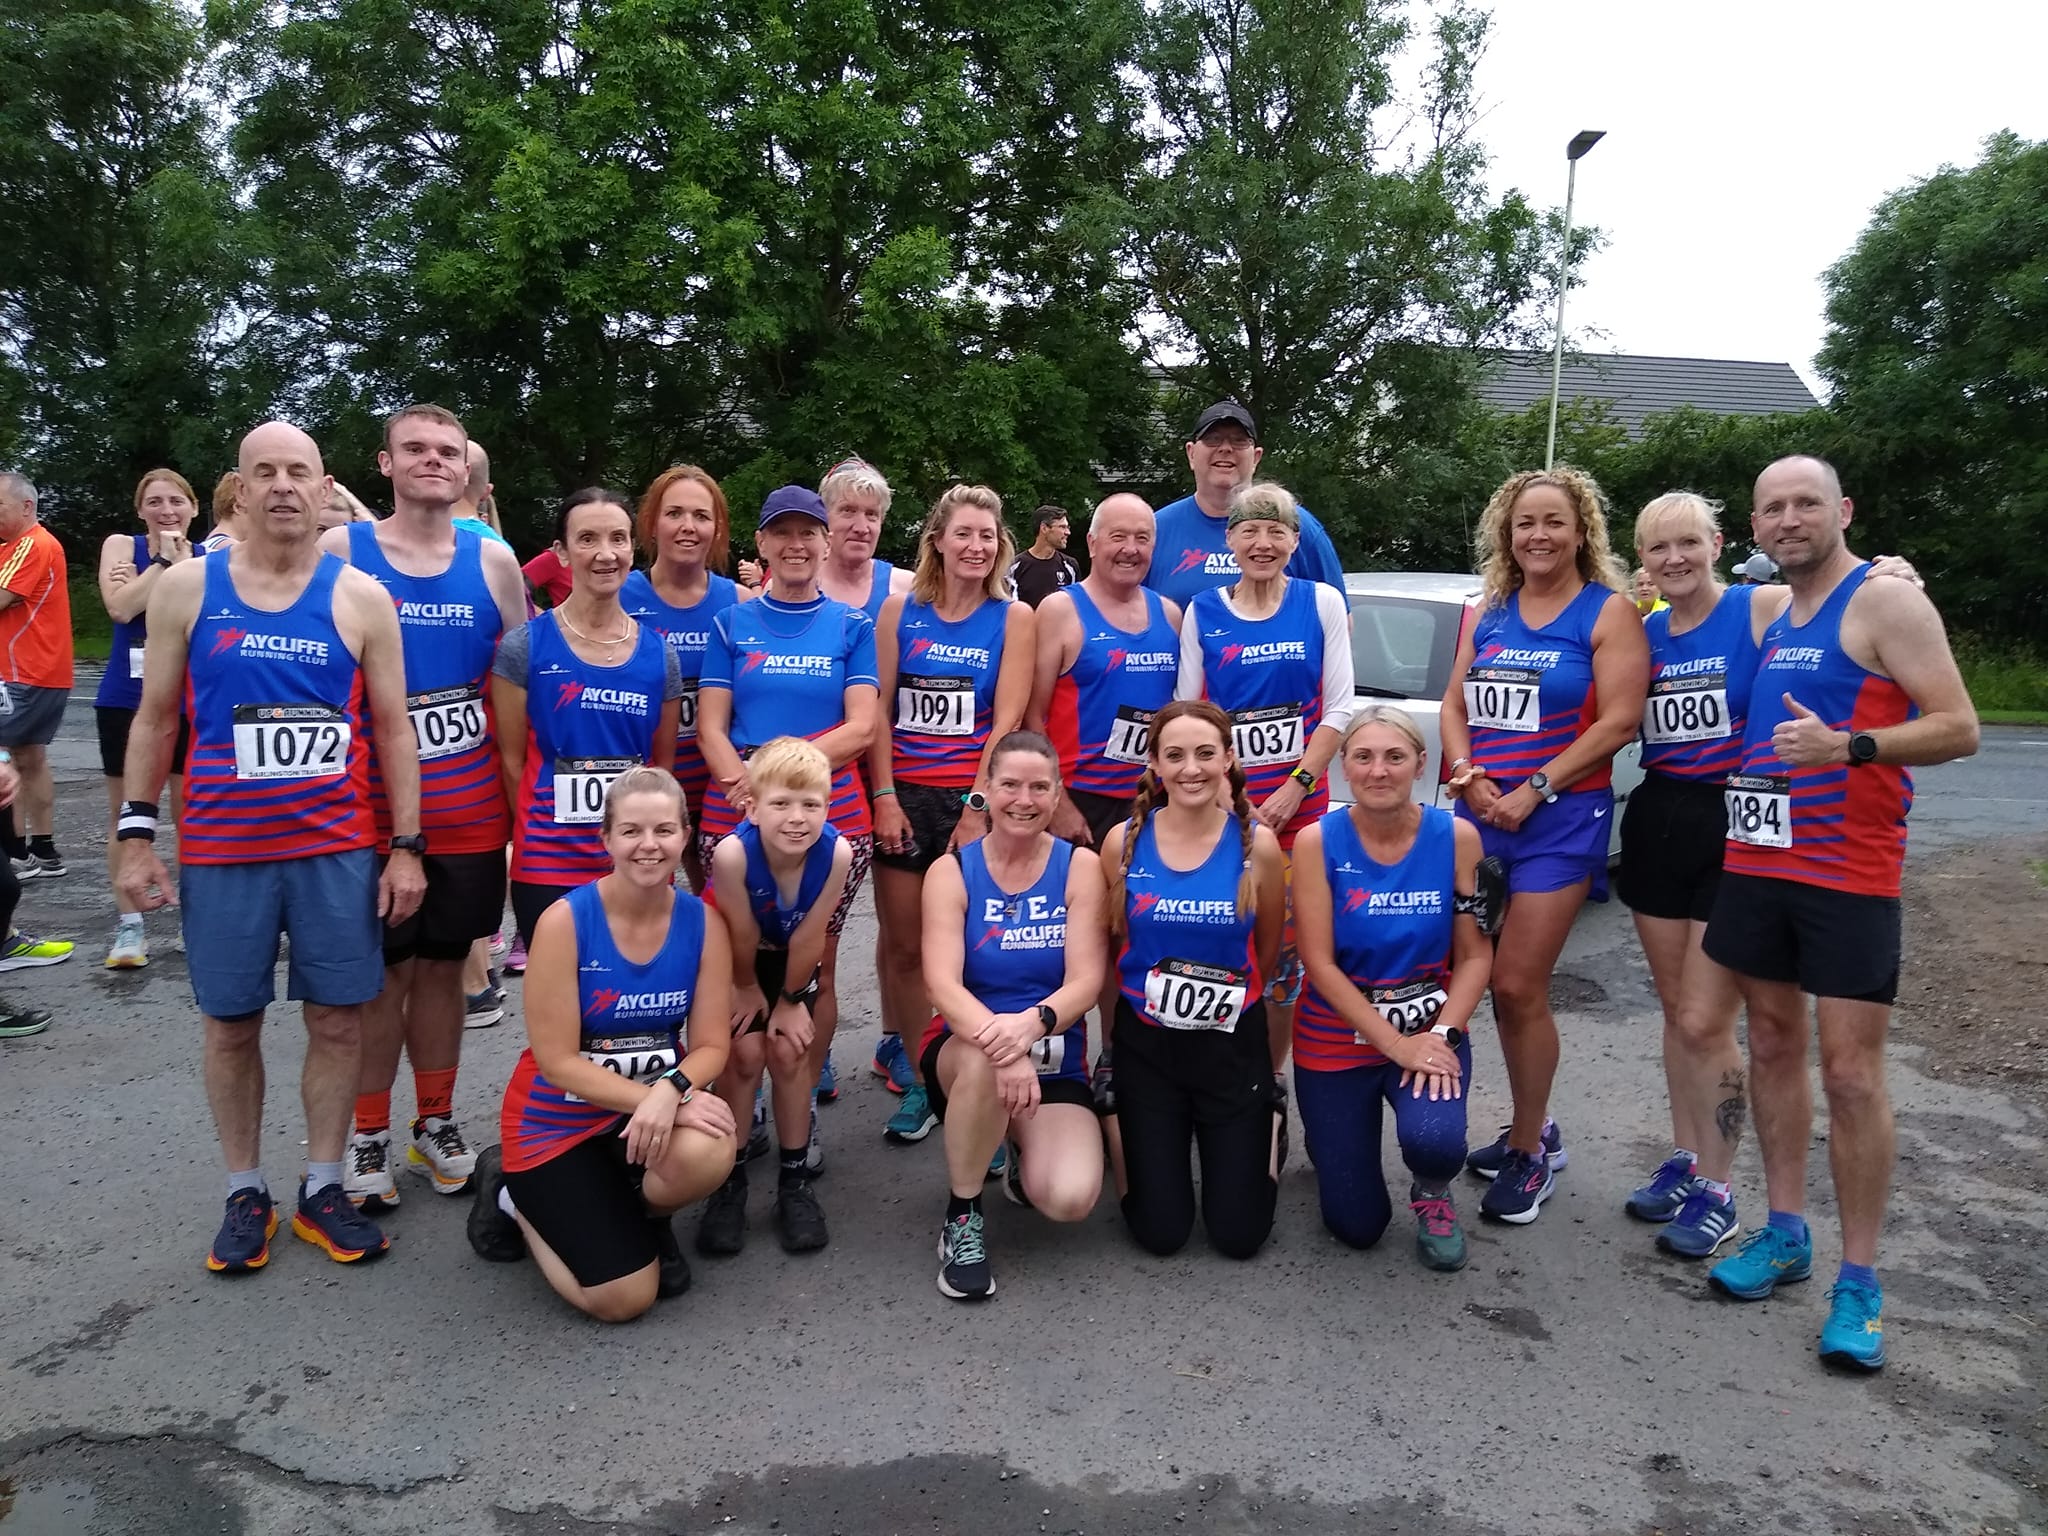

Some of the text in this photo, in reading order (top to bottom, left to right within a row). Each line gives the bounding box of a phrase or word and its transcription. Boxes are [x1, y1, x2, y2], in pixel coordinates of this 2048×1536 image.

[400, 602, 474, 619] AYCLIFFE
[400, 618, 474, 627] RUNNING CLUB
[241, 634, 329, 657] AYCLIFFE
[928, 643, 989, 663] AYCLIFFE
[1241, 641, 1305, 658] AYCLIFFE
[240, 650, 328, 666] RUNNING CLUB
[764, 655, 832, 670] AYCLIFFE
[926, 655, 988, 670] RUNNING CLUB
[1125, 652, 1175, 665] AYCLIFFE
[1241, 652, 1306, 665] RUNNING CLUB
[1492, 659, 1530, 667] RUNNING
[1496, 649, 1561, 662] AYCLIFFE
[1771, 648, 1824, 663] AYCLIFFE
[809, 669, 832, 677] CLUB
[1660, 656, 1726, 677] AYCLIFFE
[1797, 663, 1819, 671] CLUB
[581, 687, 648, 708] AYCLIFFE
[1475, 685, 1532, 720] 1017
[580, 702, 647, 716] RUNNING CLUB
[911, 693, 962, 726] 1091
[1653, 694, 1719, 734] 1080
[410, 703, 480, 749] 1050
[255, 726, 340, 767] 1072
[1237, 721, 1298, 758] 1037
[1368, 891, 1441, 907] AYCLIFFE
[1154, 899, 1235, 916] AYCLIFFE
[1417, 906, 1441, 914] CLUB
[1153, 914, 1235, 924] RUNNING CLUB
[1001, 941, 1046, 950] RUNNING
[616, 990, 687, 1010] AYCLIFFE
[1160, 978, 1233, 1022] 1026
[614, 1008, 662, 1019] RUNNING
